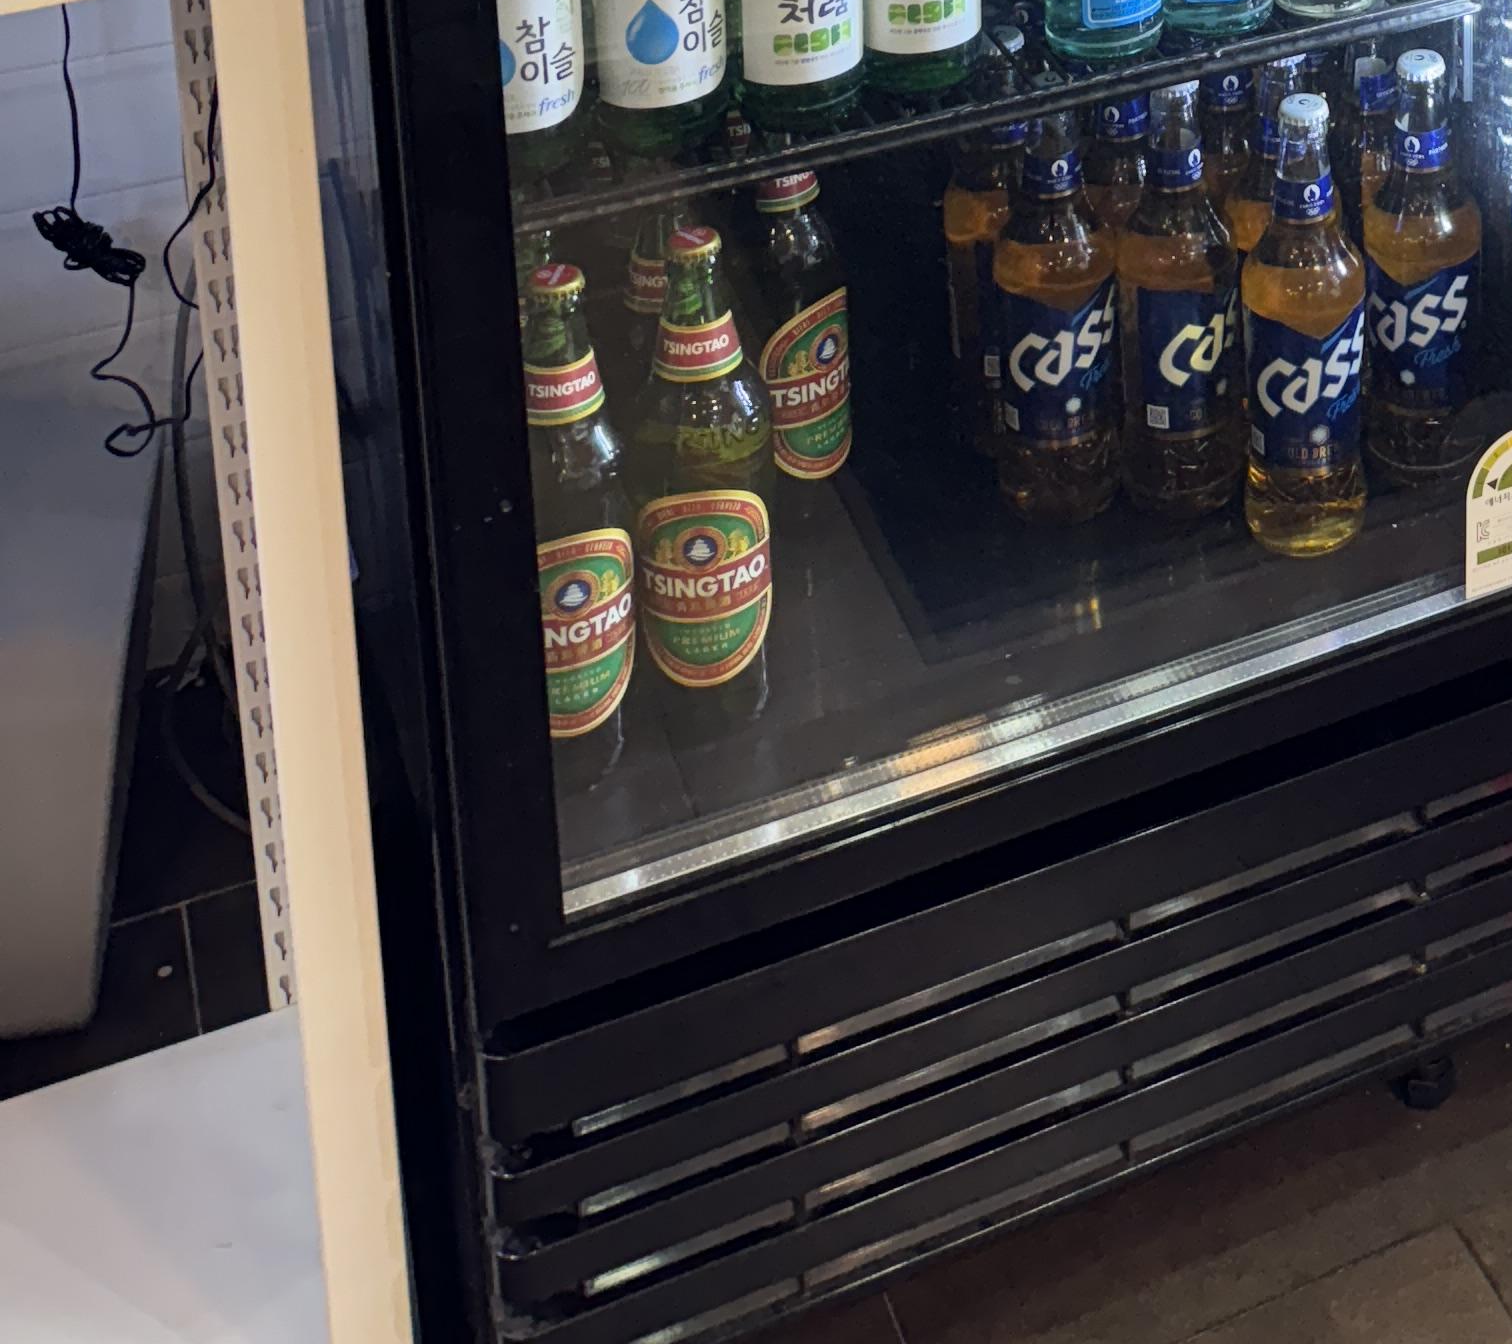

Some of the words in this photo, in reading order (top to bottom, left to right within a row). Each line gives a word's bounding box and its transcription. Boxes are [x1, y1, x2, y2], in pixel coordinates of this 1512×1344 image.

[538, 89, 576, 116] fresh
[664, 334, 729, 356] TSINGTAO
[528, 370, 596, 398] TSINGTAO
[642, 553, 766, 599] TSINGTAO
